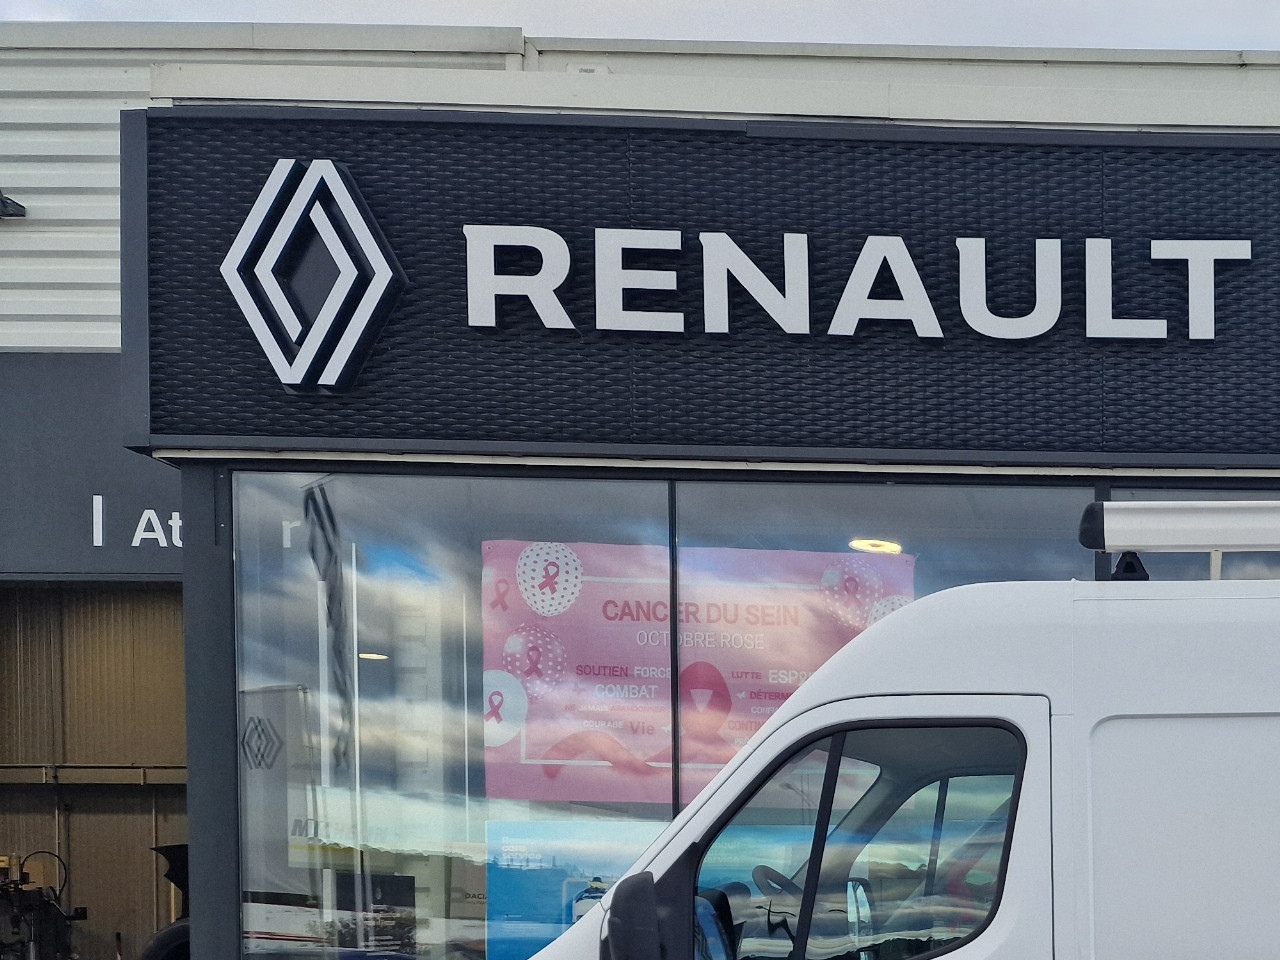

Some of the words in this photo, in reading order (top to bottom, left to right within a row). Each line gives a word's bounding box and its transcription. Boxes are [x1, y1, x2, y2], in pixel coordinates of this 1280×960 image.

[463, 225, 1252, 341] RENAULT
[131, 509, 184, 549] At
[706, 603, 739, 625] DU
[746, 605, 801, 627] SEIN
[720, 633, 765, 650] ROSE
[576, 665, 628, 677] SOUTIEN
[731, 671, 762, 680] LUTTE
[594, 684, 658, 698] COMBAT
[630, 721, 655, 735] Vie
